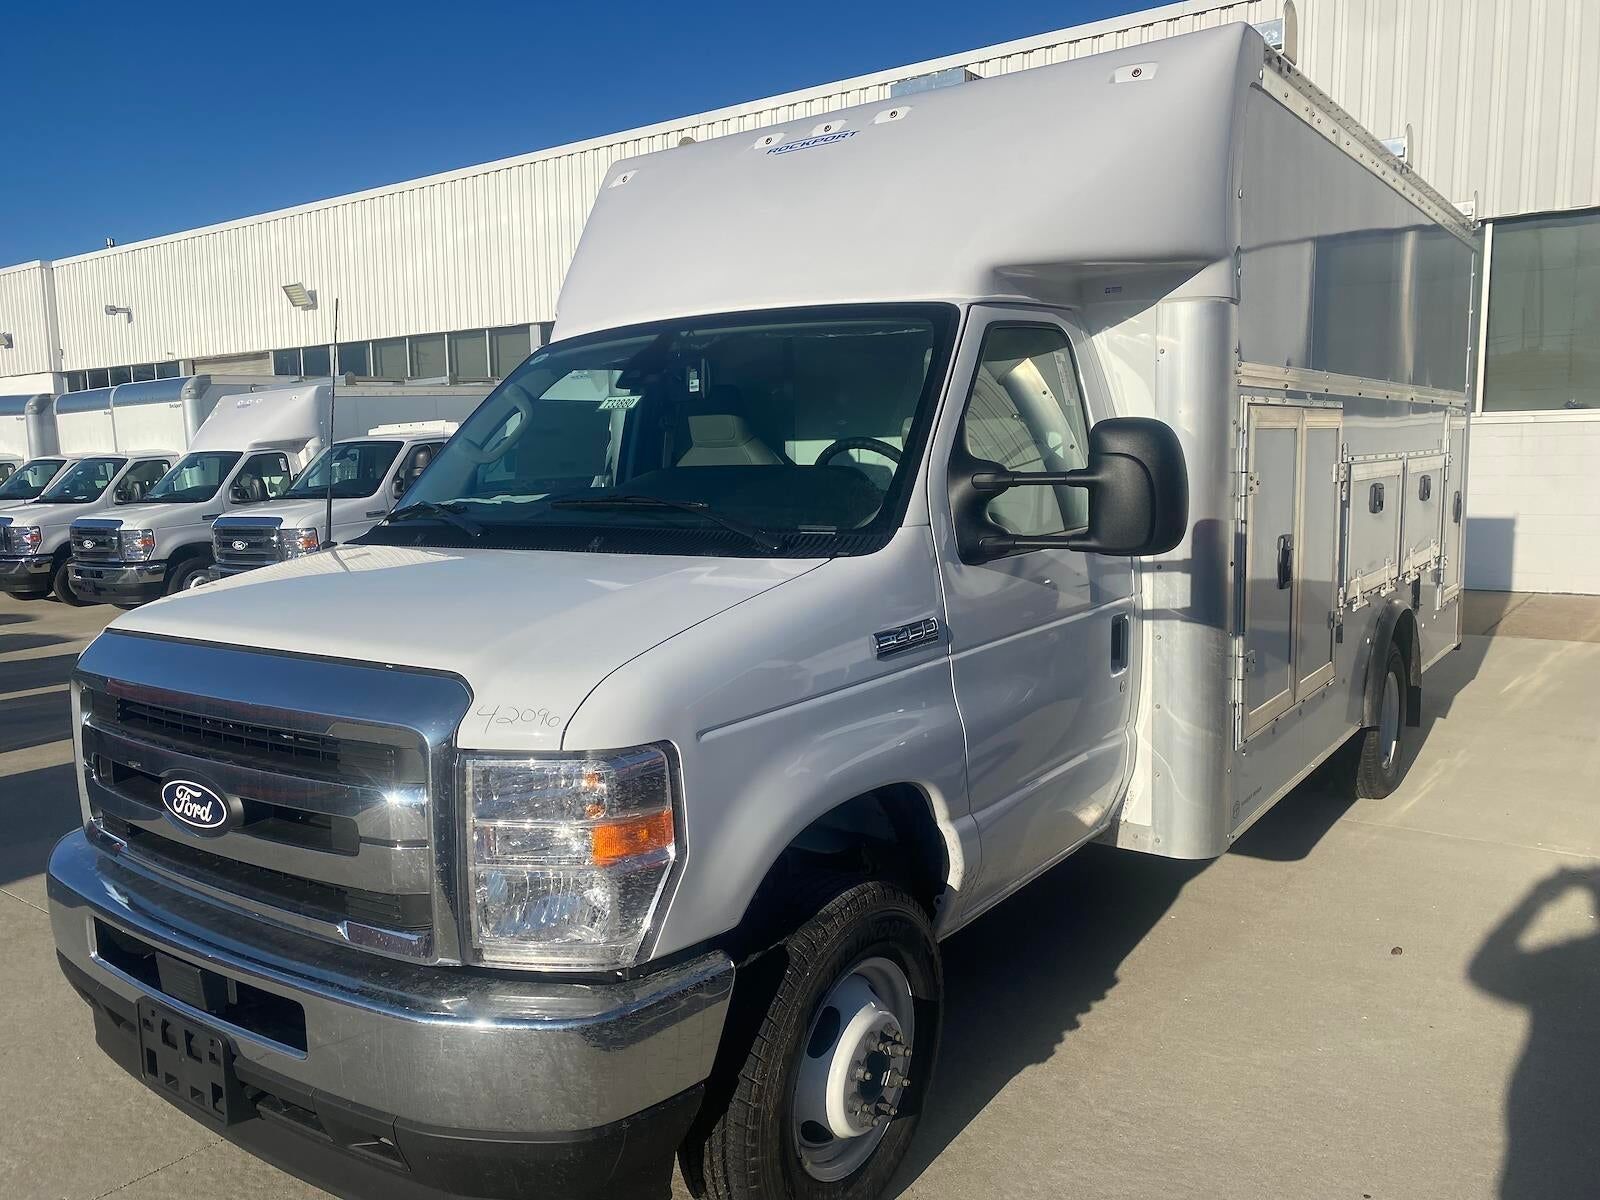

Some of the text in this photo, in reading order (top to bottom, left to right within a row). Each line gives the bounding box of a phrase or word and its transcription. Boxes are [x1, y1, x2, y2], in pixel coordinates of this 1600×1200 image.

[766, 130, 857, 155] ROCKPORT
[476, 704, 561, 735] 42096
[173, 785, 212, 822] Ford
